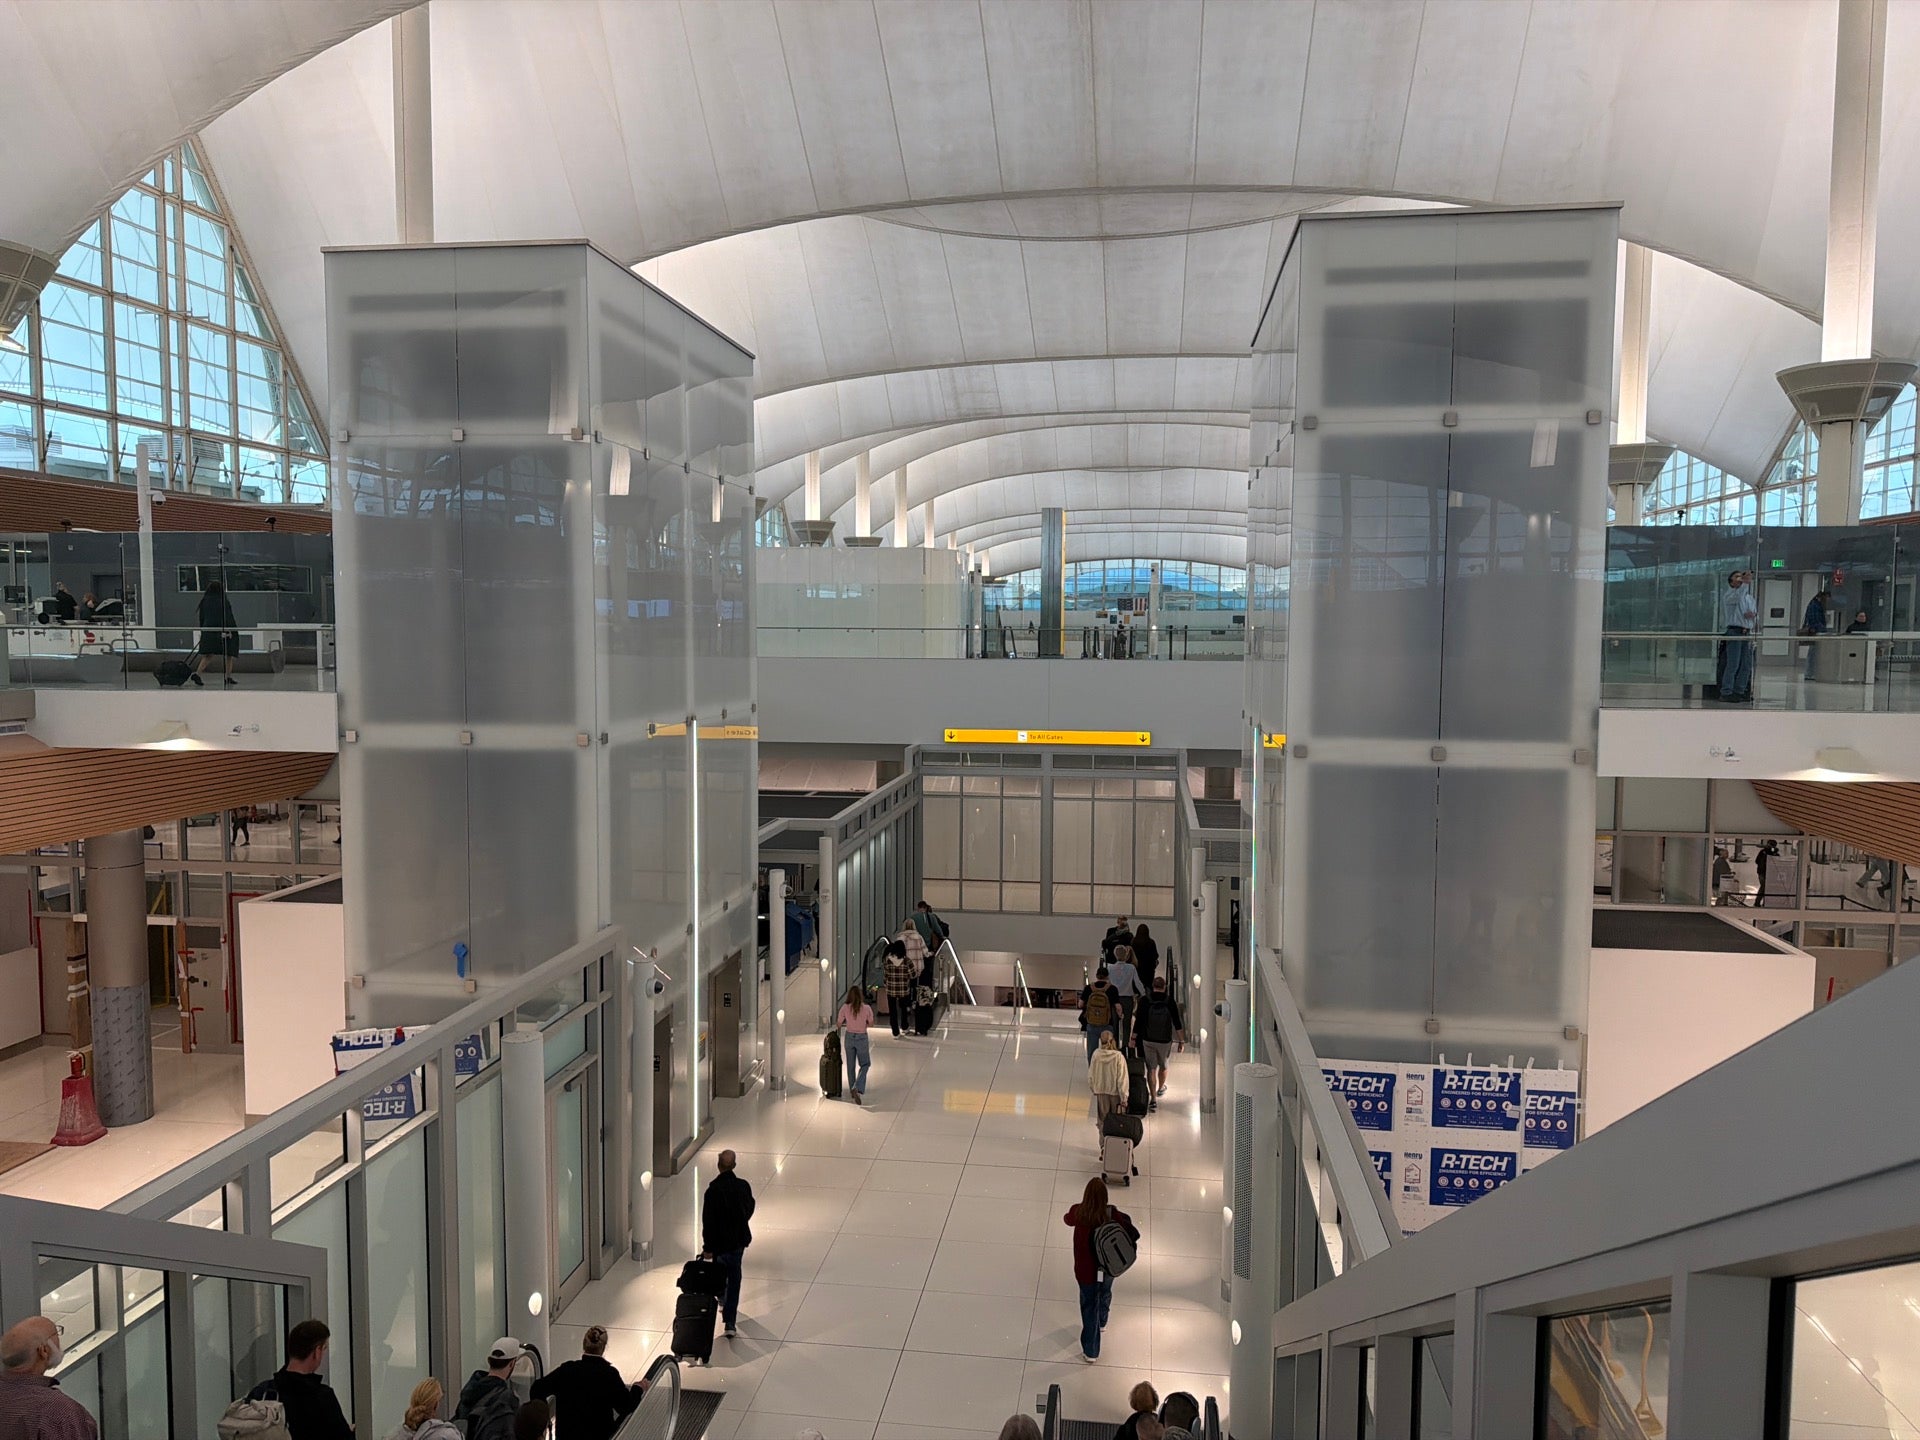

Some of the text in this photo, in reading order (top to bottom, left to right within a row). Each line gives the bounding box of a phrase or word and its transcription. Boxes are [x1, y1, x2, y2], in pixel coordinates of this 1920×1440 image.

[342, 1031, 395, 1046] RTECH
[1406, 1072, 1425, 1080] Henry
[1443, 1074, 1510, 1092] R-TECH
[364, 1100, 406, 1116] R-TEC
[1525, 1094, 1566, 1112] ECH
[1404, 1152, 1422, 1160] Henry
[1440, 1153, 1508, 1172] R-TECH
[1402, 1230, 1419, 1238] Henr
